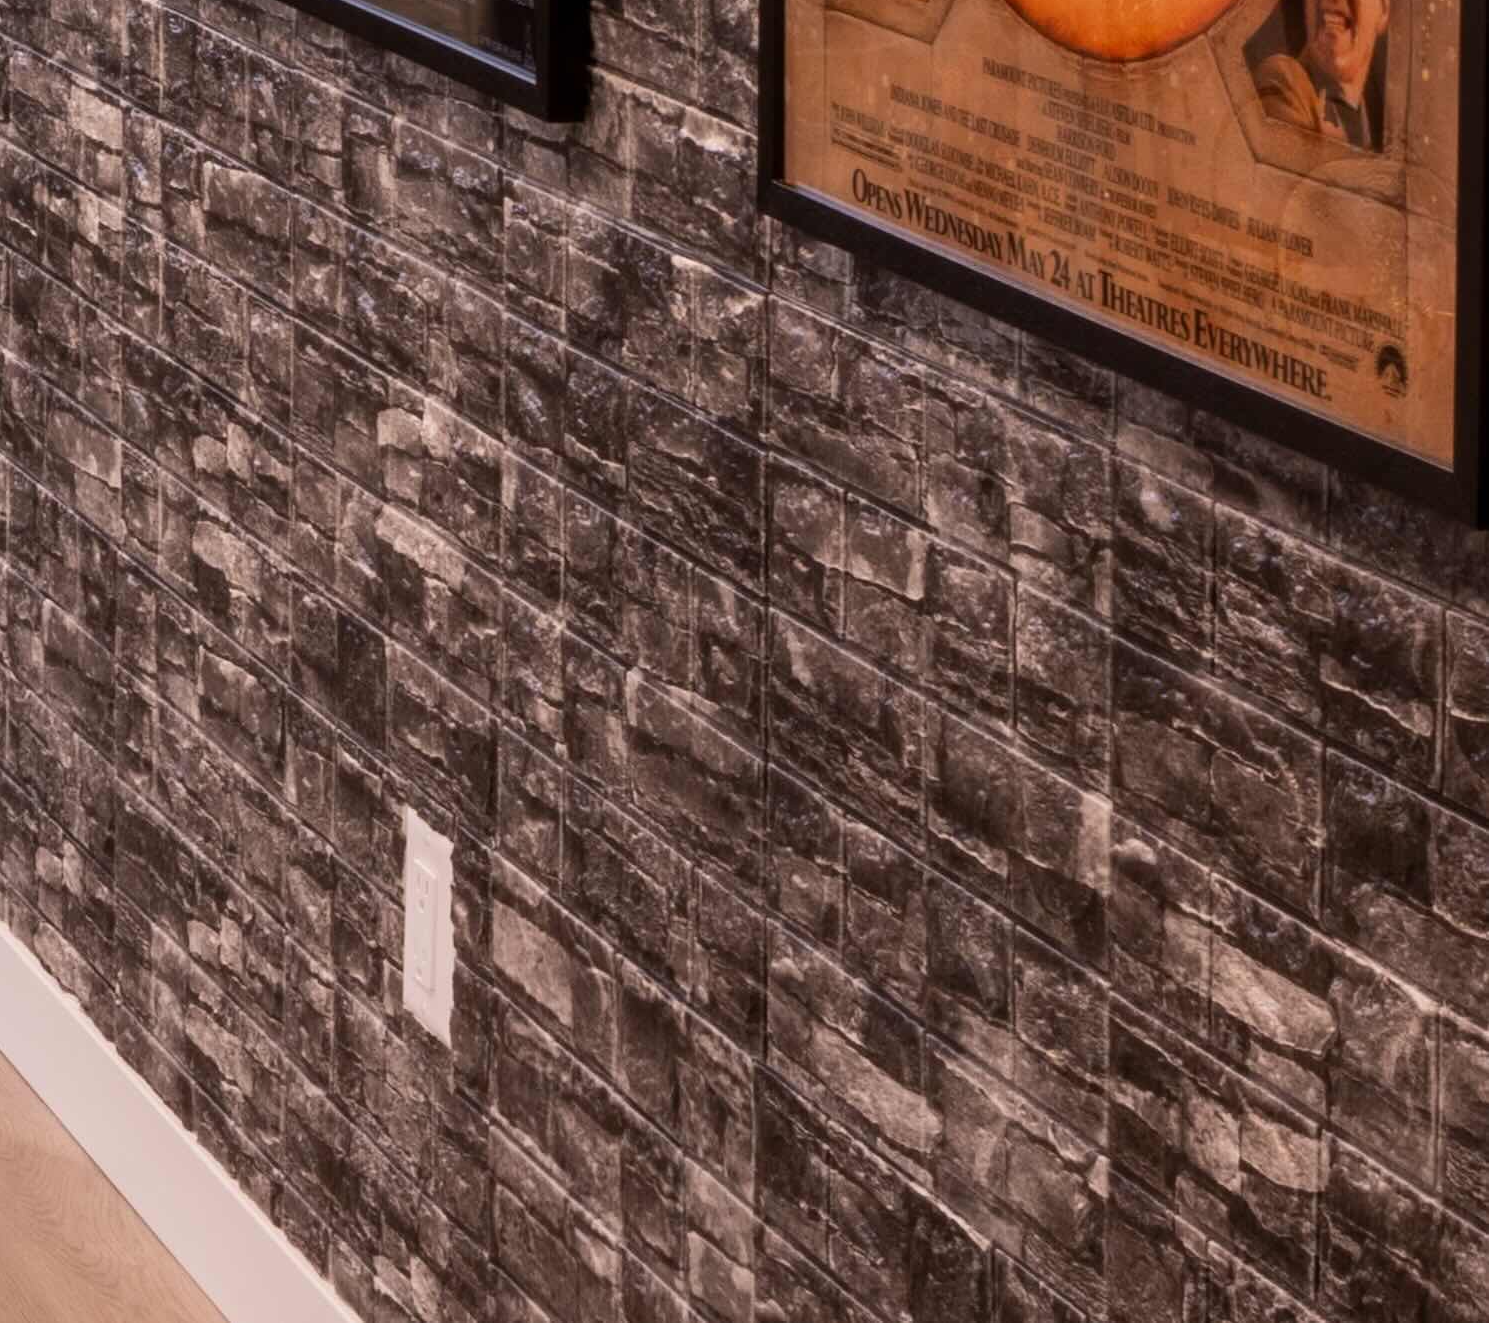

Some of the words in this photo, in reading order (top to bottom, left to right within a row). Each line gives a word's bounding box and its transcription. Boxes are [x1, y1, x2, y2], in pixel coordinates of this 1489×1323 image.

[852, 168, 902, 219] OPENS
[904, 189, 1003, 259] WEDNESDAY
[1006, 231, 1046, 281] MAY
[1050, 249, 1071, 290] 24
[1077, 269, 1096, 301] AT
[1099, 269, 1190, 343] THEATRES
[1194, 308, 1332, 401] EVERYWHERE.
